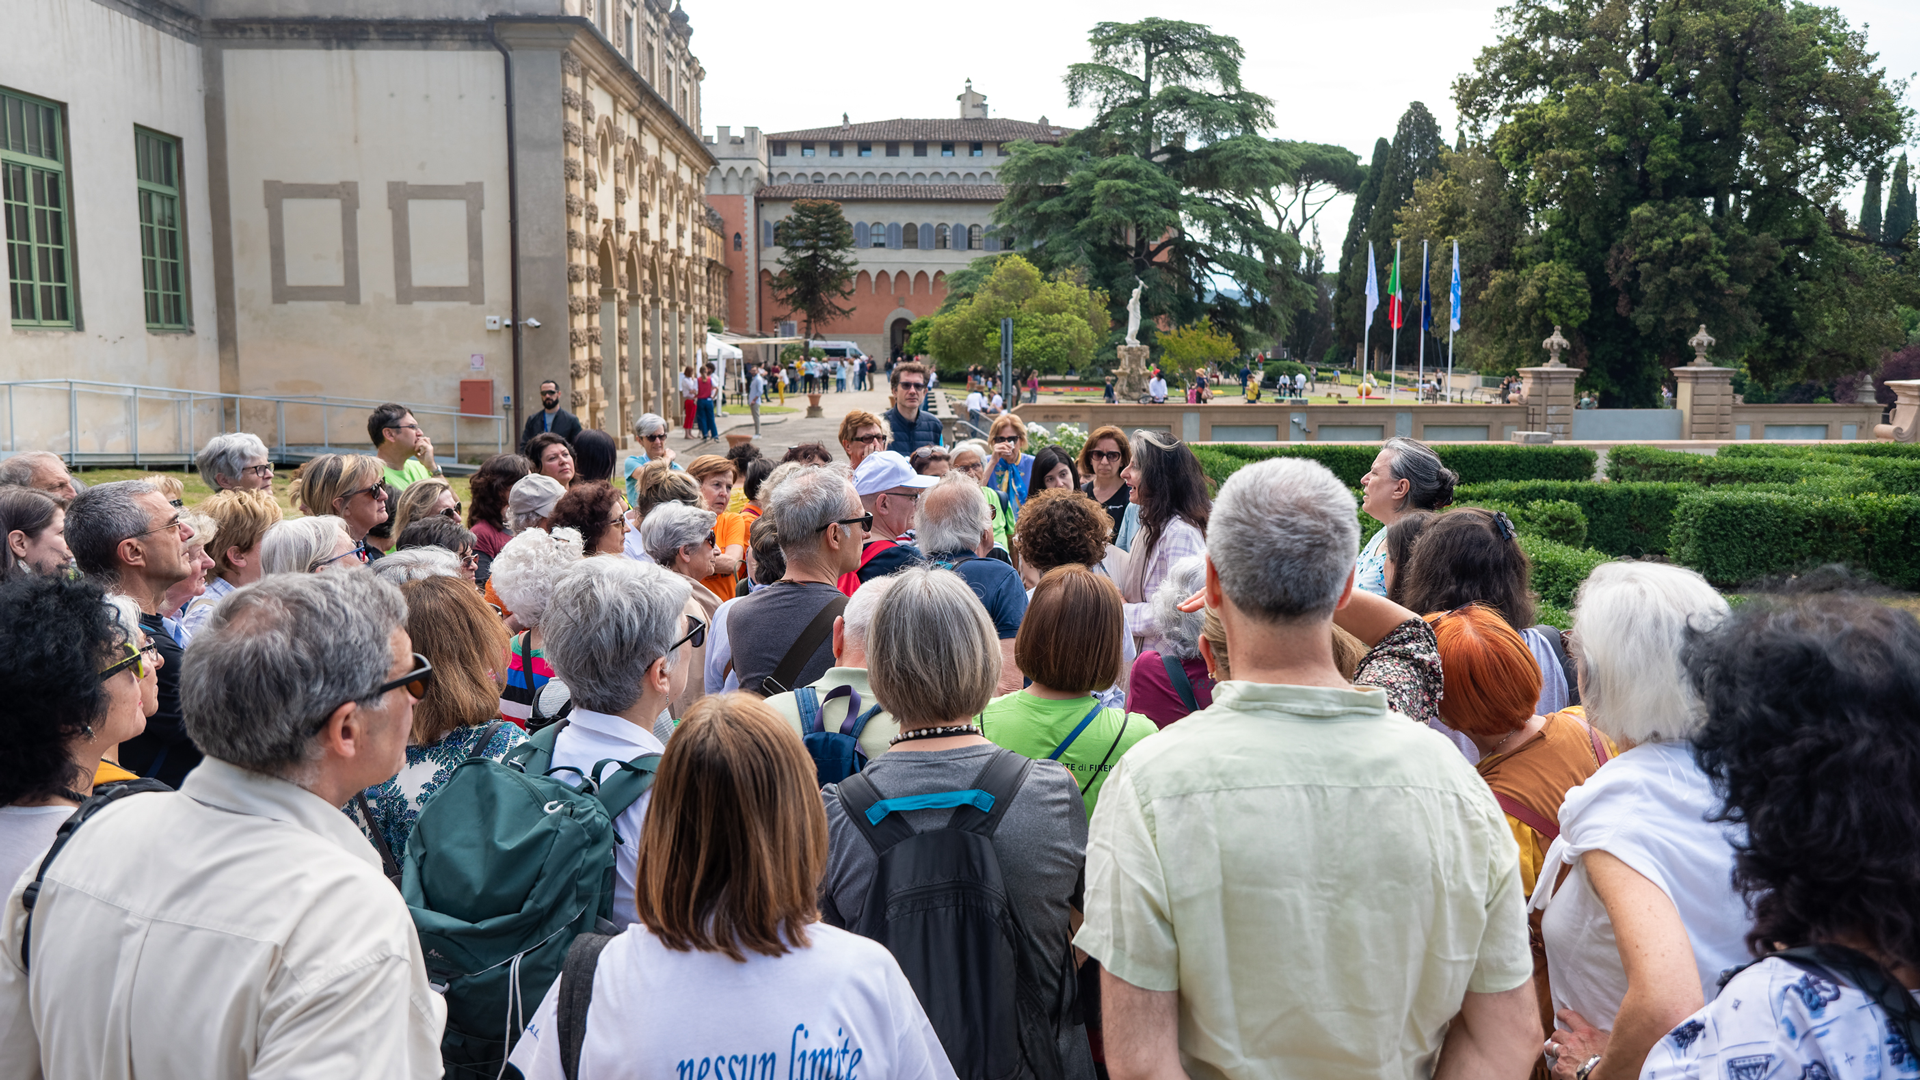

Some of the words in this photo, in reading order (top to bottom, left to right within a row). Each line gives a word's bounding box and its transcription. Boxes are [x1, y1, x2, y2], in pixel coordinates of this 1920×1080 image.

[1062, 763, 1075, 771] TE
[676, 1051, 776, 1080] nessun
[789, 1023, 862, 1080] limite
